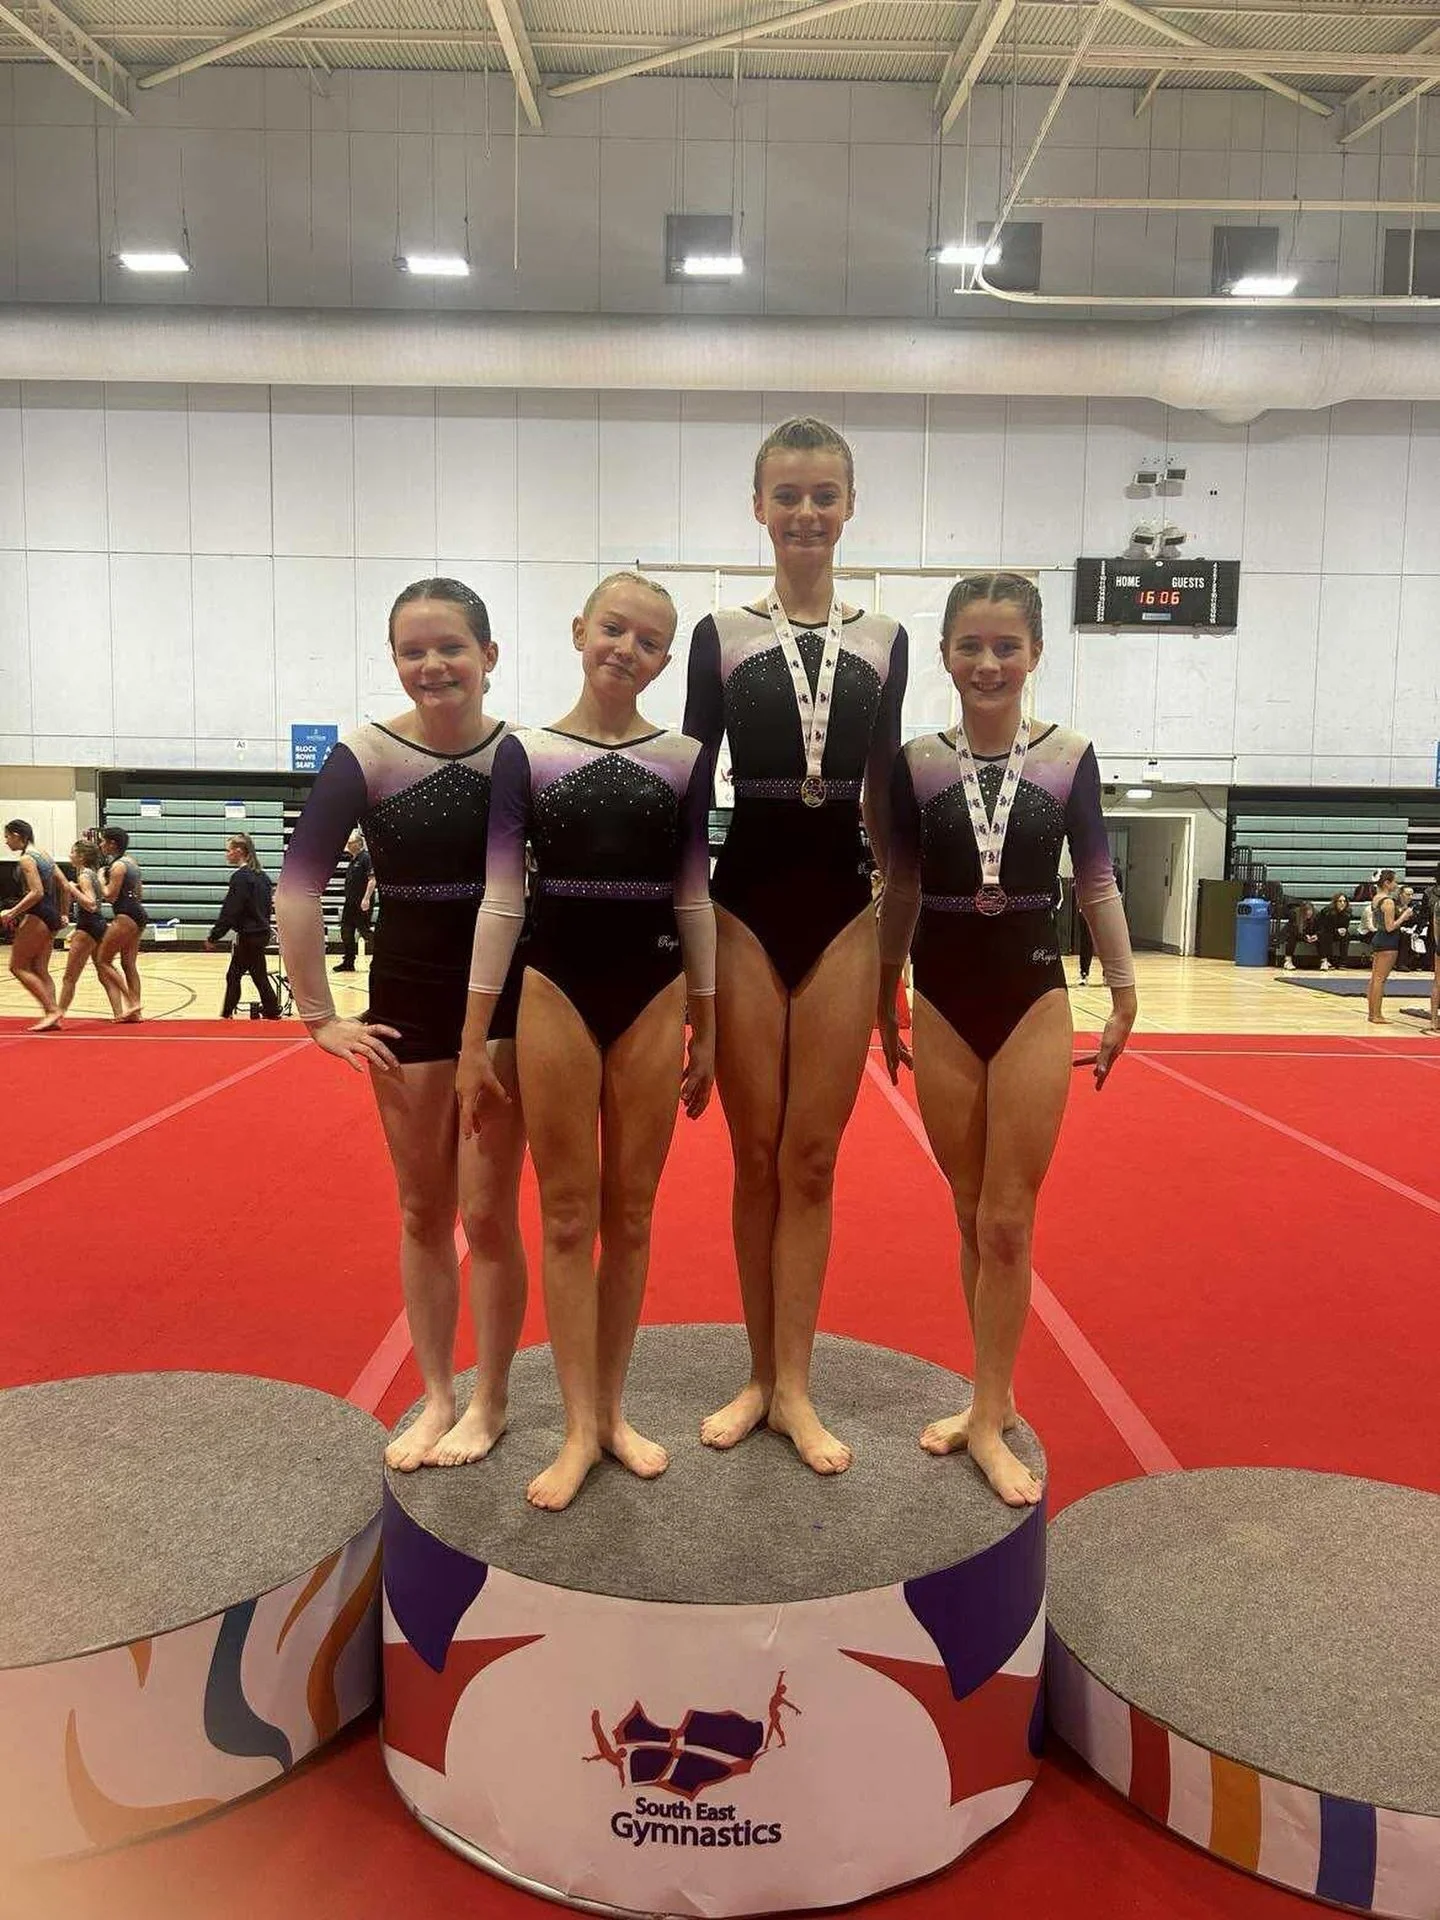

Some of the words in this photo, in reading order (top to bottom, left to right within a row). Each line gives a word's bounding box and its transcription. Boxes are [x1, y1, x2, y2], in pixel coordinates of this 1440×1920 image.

[1115, 575, 1141, 588] HOME
[1171, 577, 1205, 588] GUESTS
[635, 1797, 691, 1820] South
[696, 1802, 736, 1821] East
[611, 1811, 782, 1847] Gymnastics
